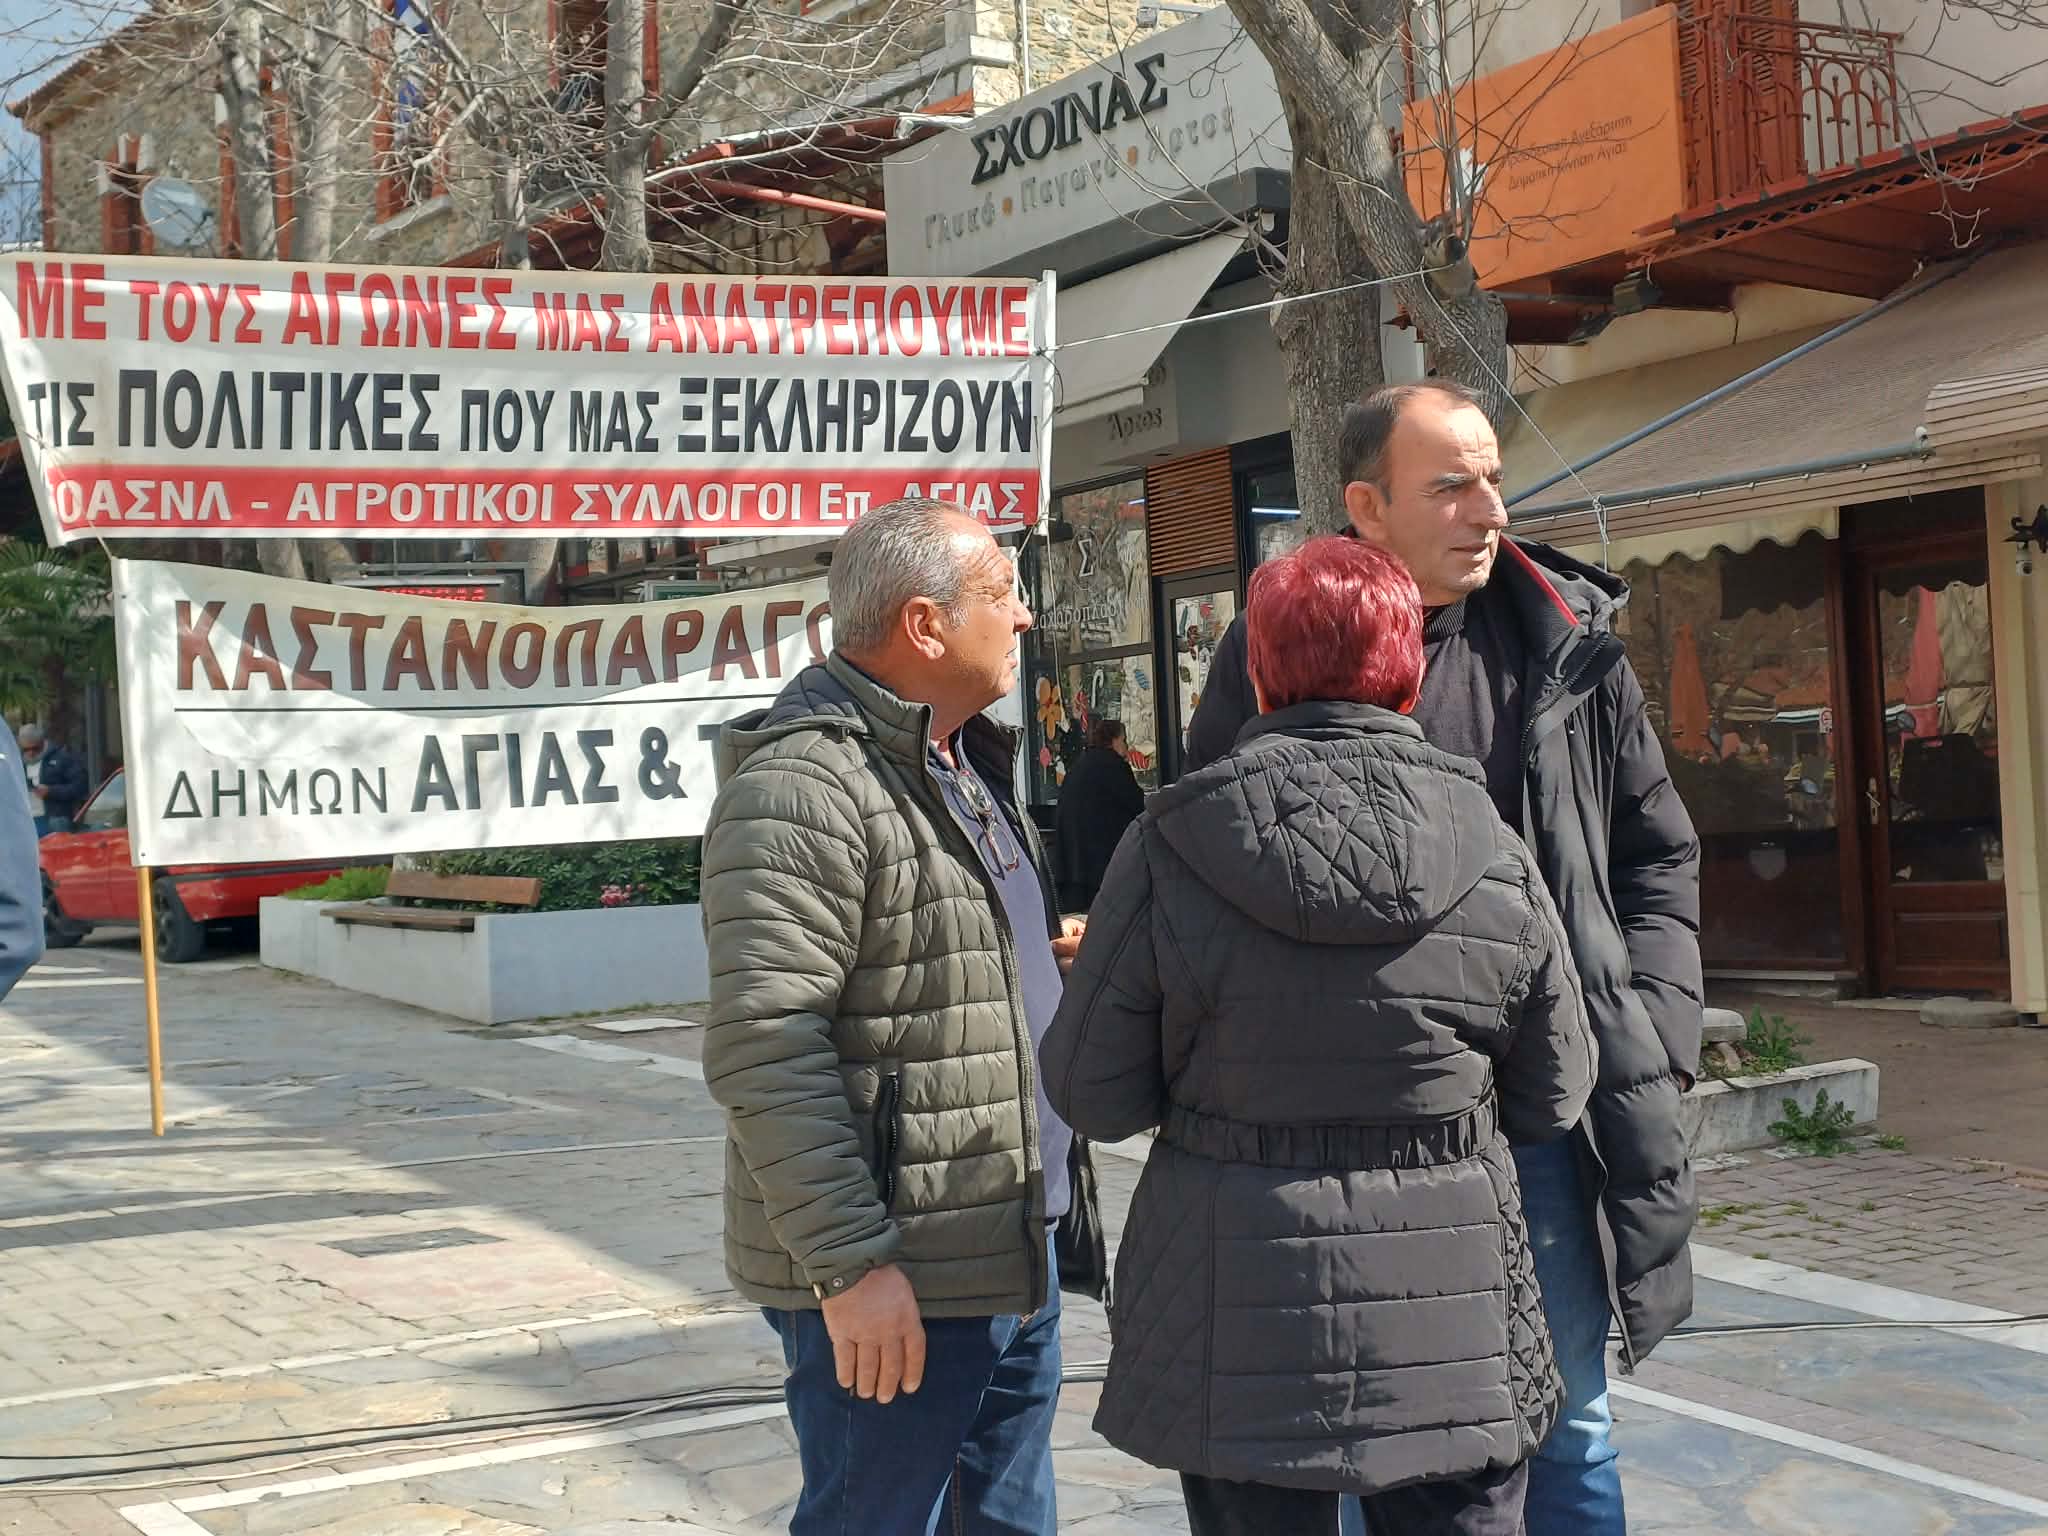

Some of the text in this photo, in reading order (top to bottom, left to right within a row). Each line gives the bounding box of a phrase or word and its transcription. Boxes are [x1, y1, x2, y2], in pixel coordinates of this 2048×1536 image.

[970, 53, 1168, 184] ΣΧΟΙΝΑΣ
[925, 192, 996, 248] Γλυκό
[16, 262, 1030, 356] ΜΕ ΤΟΥΣ ΑΓΩΝΕΣ ΜΑΣ ΑΝΑΤΡΕΠΟΥΜΕ
[27, 369, 1032, 453] ΤΙΣ ΠΟΛΙΤΙΚΕΣ ΠΟΥ ΜΑΣ ΞΕΚΛΗΡΙΖΟΥΝ
[55, 479, 232, 523] ΟΑΣΝΛ
[287, 482, 551, 522] ΑΓΡΟΤΙΚΟΙ
[571, 483, 800, 522] ΣΥΛΛΟΓΟΙ
[162, 766, 389, 818] ΔΗΜΩΝ
[411, 729, 619, 812] ΑΓΙΑΣ
[638, 726, 688, 801] &
